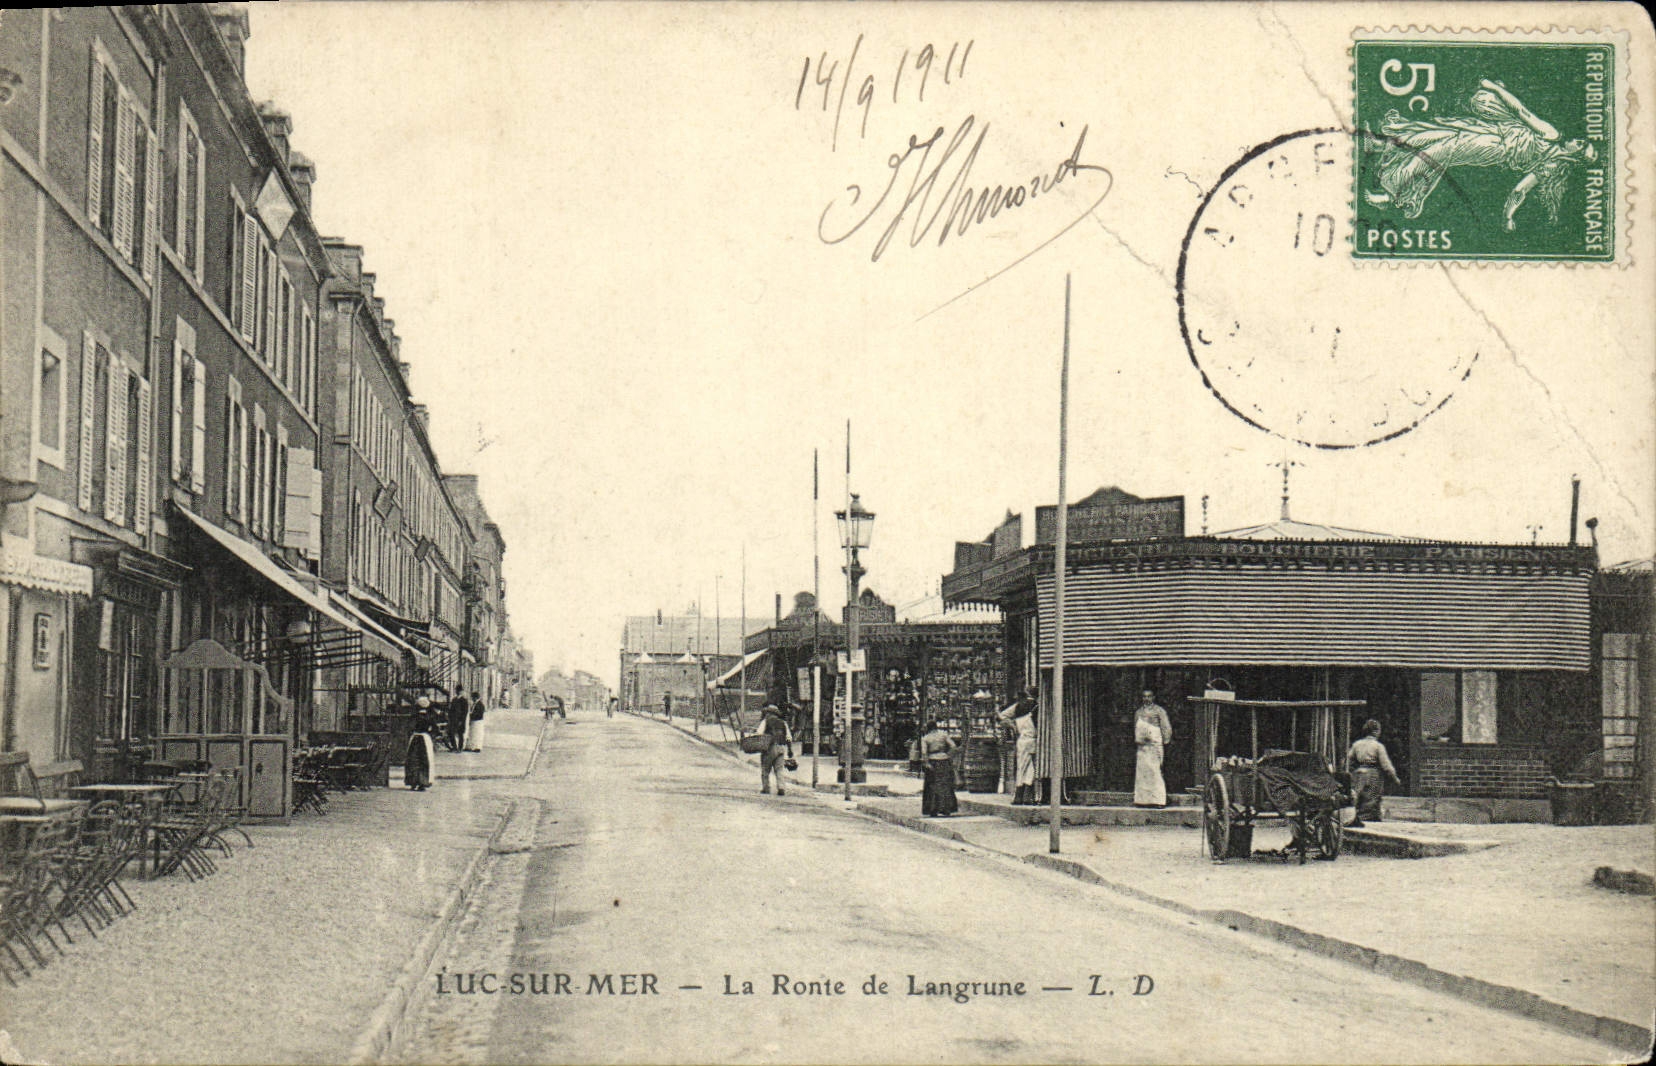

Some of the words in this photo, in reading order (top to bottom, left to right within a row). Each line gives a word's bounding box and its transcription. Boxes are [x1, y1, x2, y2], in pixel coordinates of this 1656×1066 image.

[892, 38, 975, 103] 1911
[1585, 51, 1604, 141] REPUBLIQUE
[1366, 228, 1452, 250] POSTES
[1583, 168, 1604, 252] FRANÇAISE
[1220, 543, 1376, 559] BOUCHERIE
[1424, 547, 1576, 562] PARISIENNE
